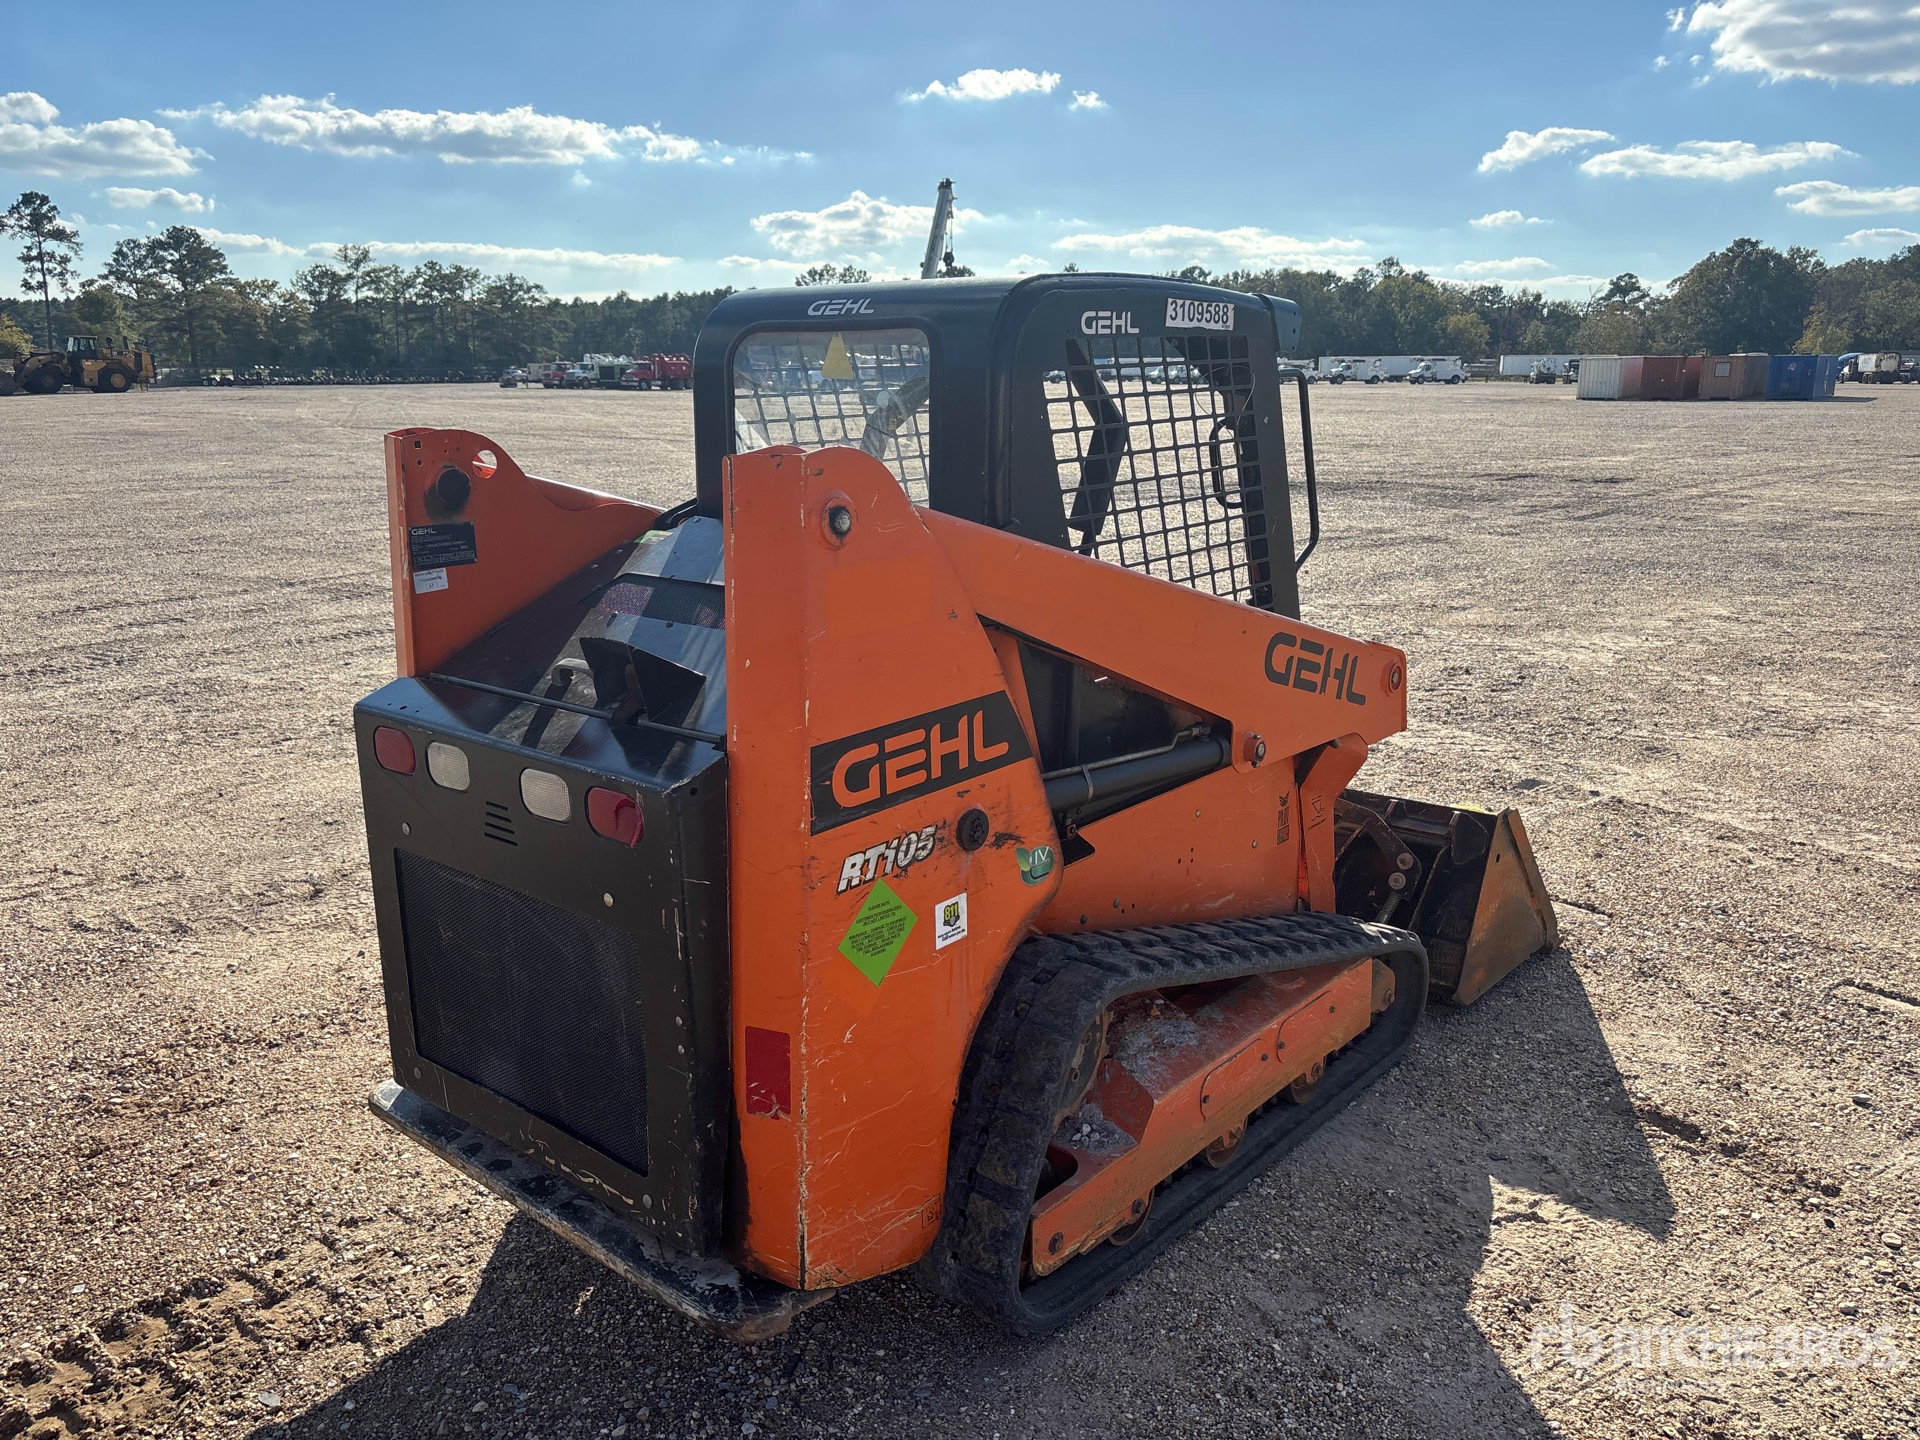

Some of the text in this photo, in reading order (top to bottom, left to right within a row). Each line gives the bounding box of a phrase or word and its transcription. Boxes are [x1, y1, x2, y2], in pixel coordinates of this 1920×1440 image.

[807, 297, 875, 316] GEHL
[1169, 299, 1229, 325] 3109588
[1080, 310, 1140, 335] GEHL
[411, 527, 437, 535] GEHL
[1264, 631, 1367, 706] GEHL
[831, 709, 1010, 809] GEHL
[837, 824, 938, 895] RT105
[943, 901, 959, 921] 811
